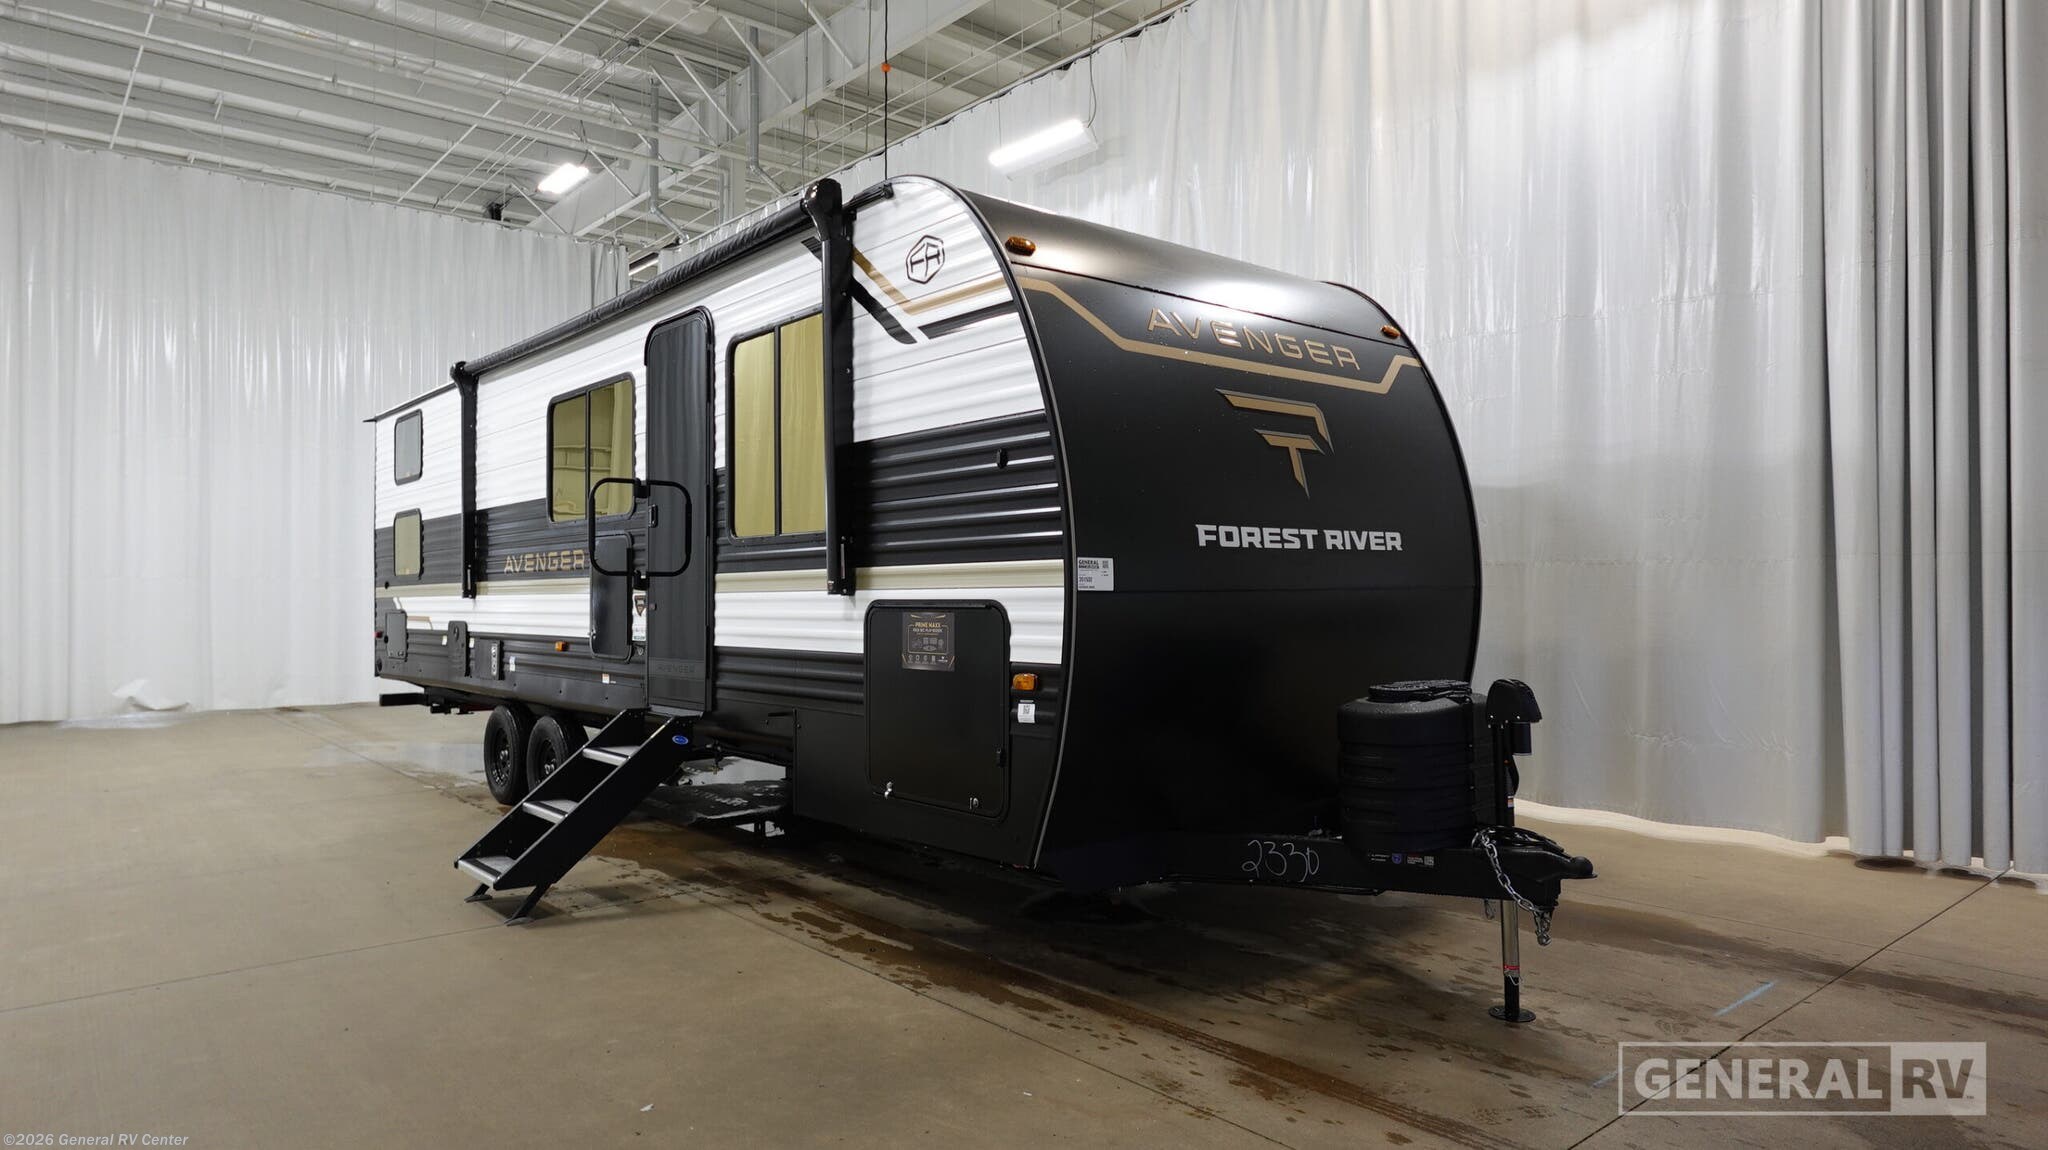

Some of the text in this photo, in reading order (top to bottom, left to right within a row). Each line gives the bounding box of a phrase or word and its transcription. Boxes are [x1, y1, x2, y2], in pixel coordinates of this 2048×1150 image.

[1148, 308, 1361, 371] AVENGER
[1195, 524, 1403, 551] FOREST RIVER
[504, 549, 585, 574] AVENGER
